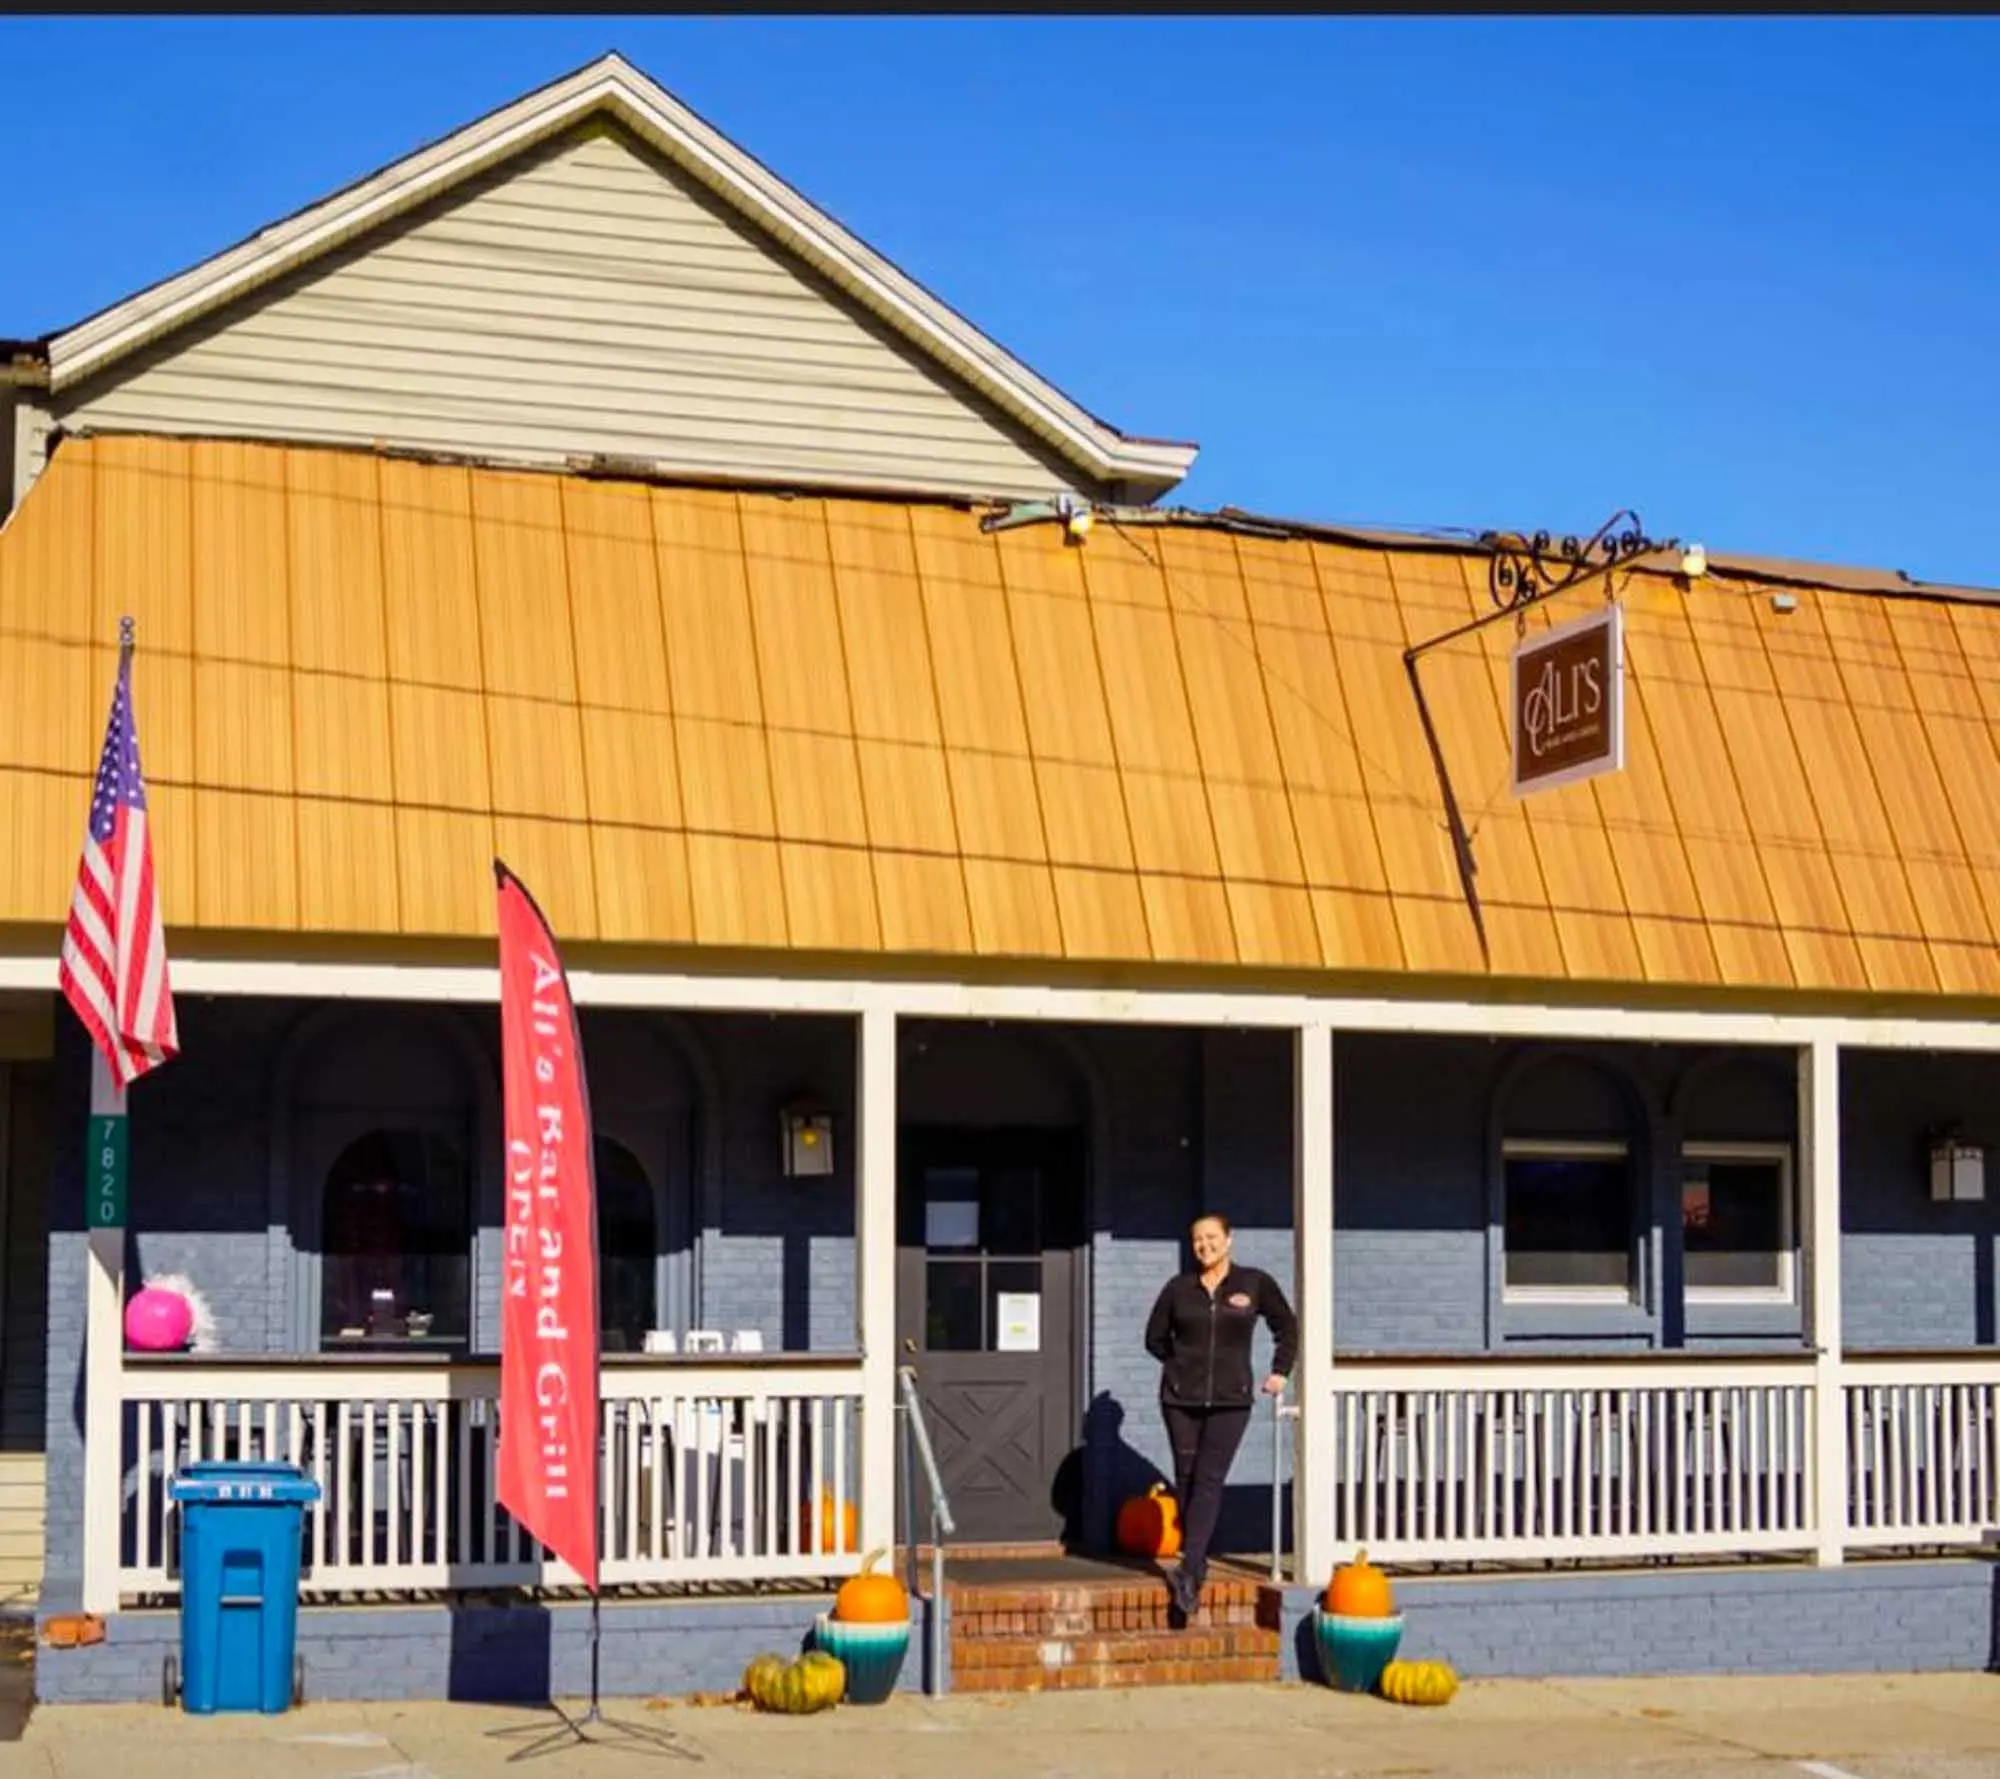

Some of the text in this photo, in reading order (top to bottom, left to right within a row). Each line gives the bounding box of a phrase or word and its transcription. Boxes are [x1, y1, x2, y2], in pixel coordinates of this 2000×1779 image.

[1523, 657, 1601, 756] ALI'S
[100, 1119, 115, 1224] 7820
[529, 951, 568, 1498] Ali's Bar and Grill
